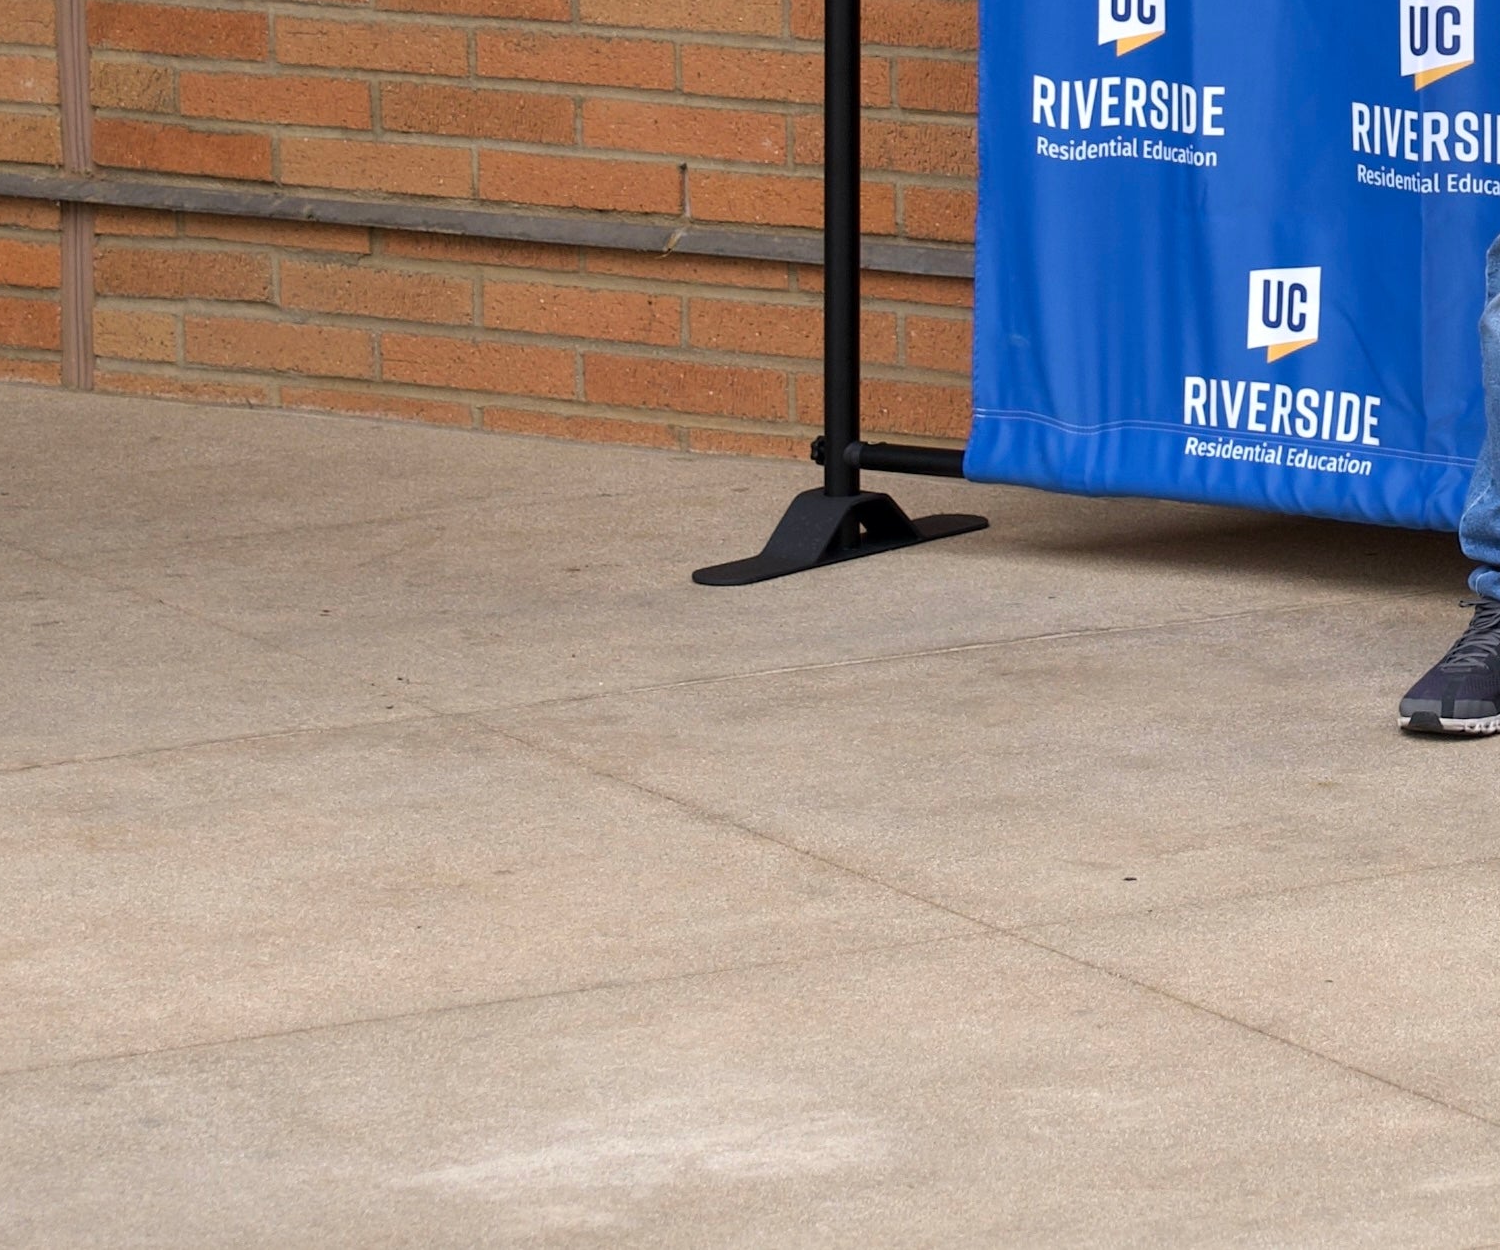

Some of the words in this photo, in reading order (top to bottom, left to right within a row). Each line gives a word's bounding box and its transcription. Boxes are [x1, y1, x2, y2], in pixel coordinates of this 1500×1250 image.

[1409, 5, 1461, 57] UC
[1033, 75, 1225, 135] RIVERSIDE
[1037, 136, 1138, 160] Residential
[1143, 140, 1217, 166] Education
[1358, 164, 1440, 193] Residential
[1261, 279, 1308, 333] UC
[1184, 377, 1380, 446] RIVERSIDE
[1185, 437, 1282, 465] Residential
[1287, 448, 1371, 475] Education
